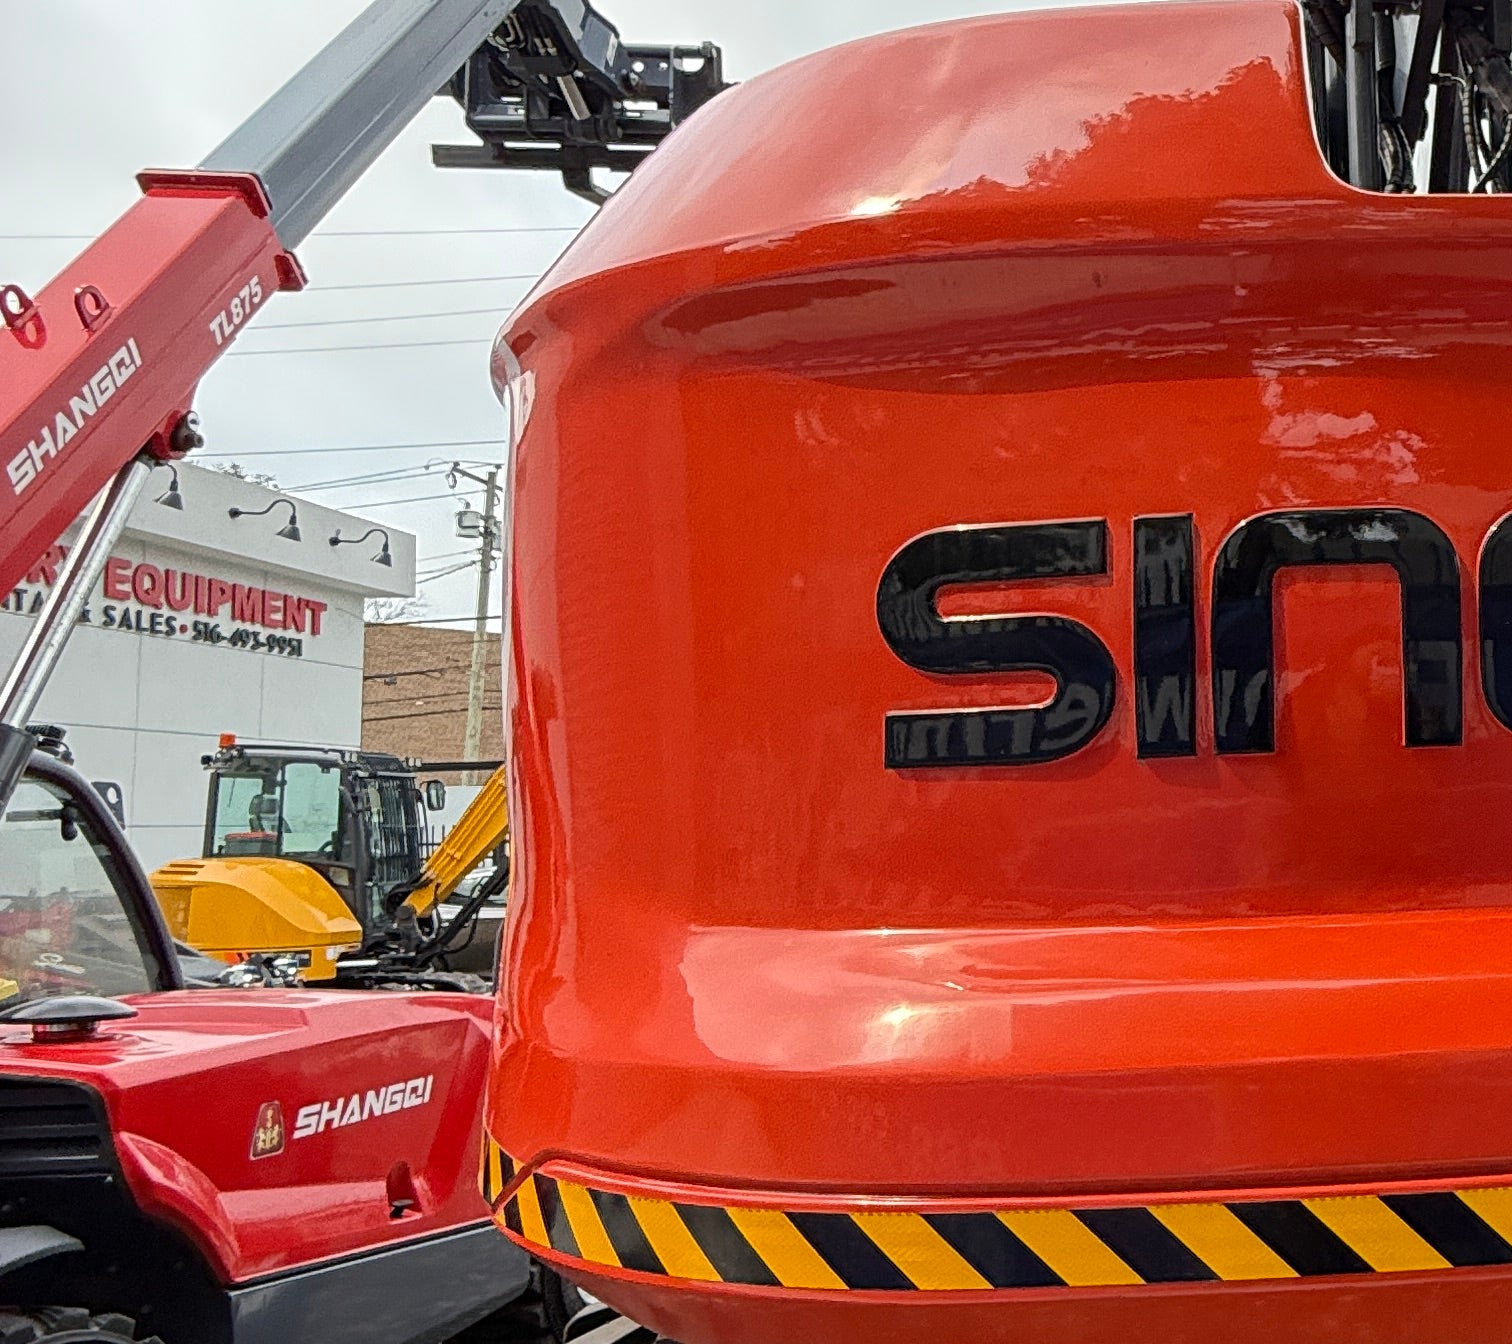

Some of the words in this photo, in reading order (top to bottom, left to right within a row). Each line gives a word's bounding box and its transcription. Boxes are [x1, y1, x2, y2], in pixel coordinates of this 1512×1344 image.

[209, 275, 262, 346] TL875
[6, 337, 142, 496] SHANGQI
[102, 604, 177, 636] SALES
[104, 556, 328, 636] EQUIPMENT
[292, 1074, 434, 1140] SHANGQI
